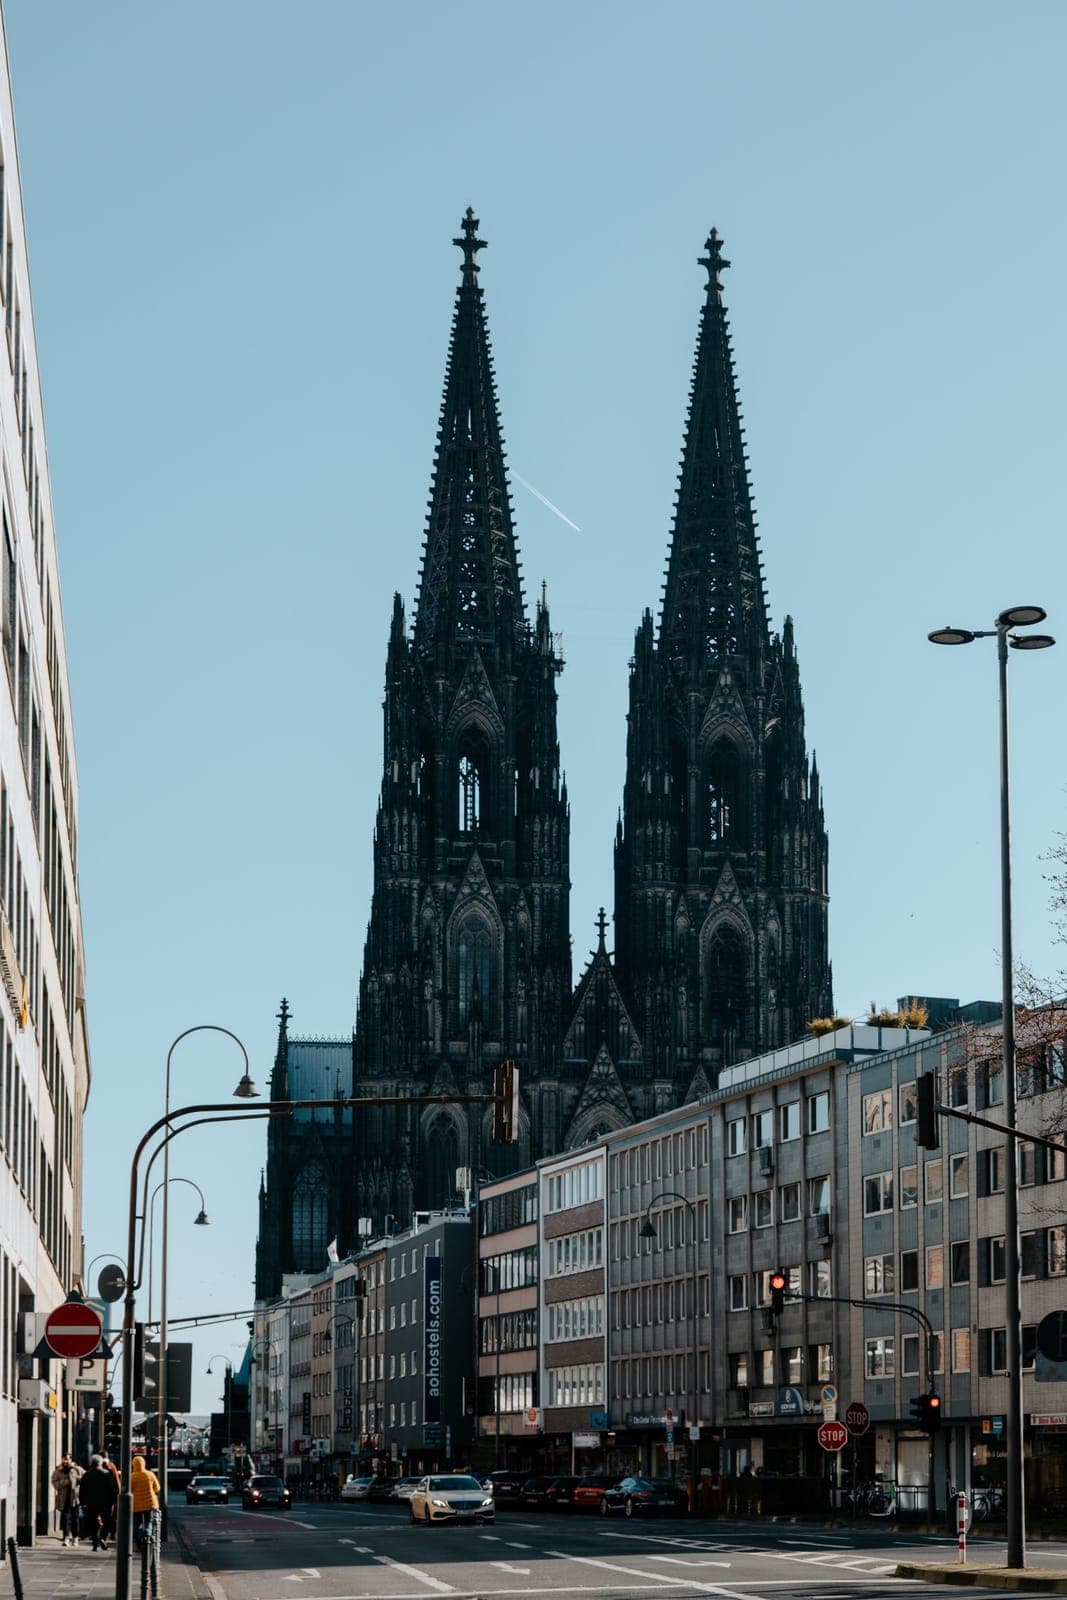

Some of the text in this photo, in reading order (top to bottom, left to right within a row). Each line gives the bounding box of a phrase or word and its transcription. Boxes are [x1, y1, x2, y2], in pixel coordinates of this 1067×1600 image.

[426, 1280, 440, 1397] aohostels.com
[79, 1359, 95, 1376] P
[847, 1411, 868, 1425] STOP
[821, 1430, 844, 1442] STOP
